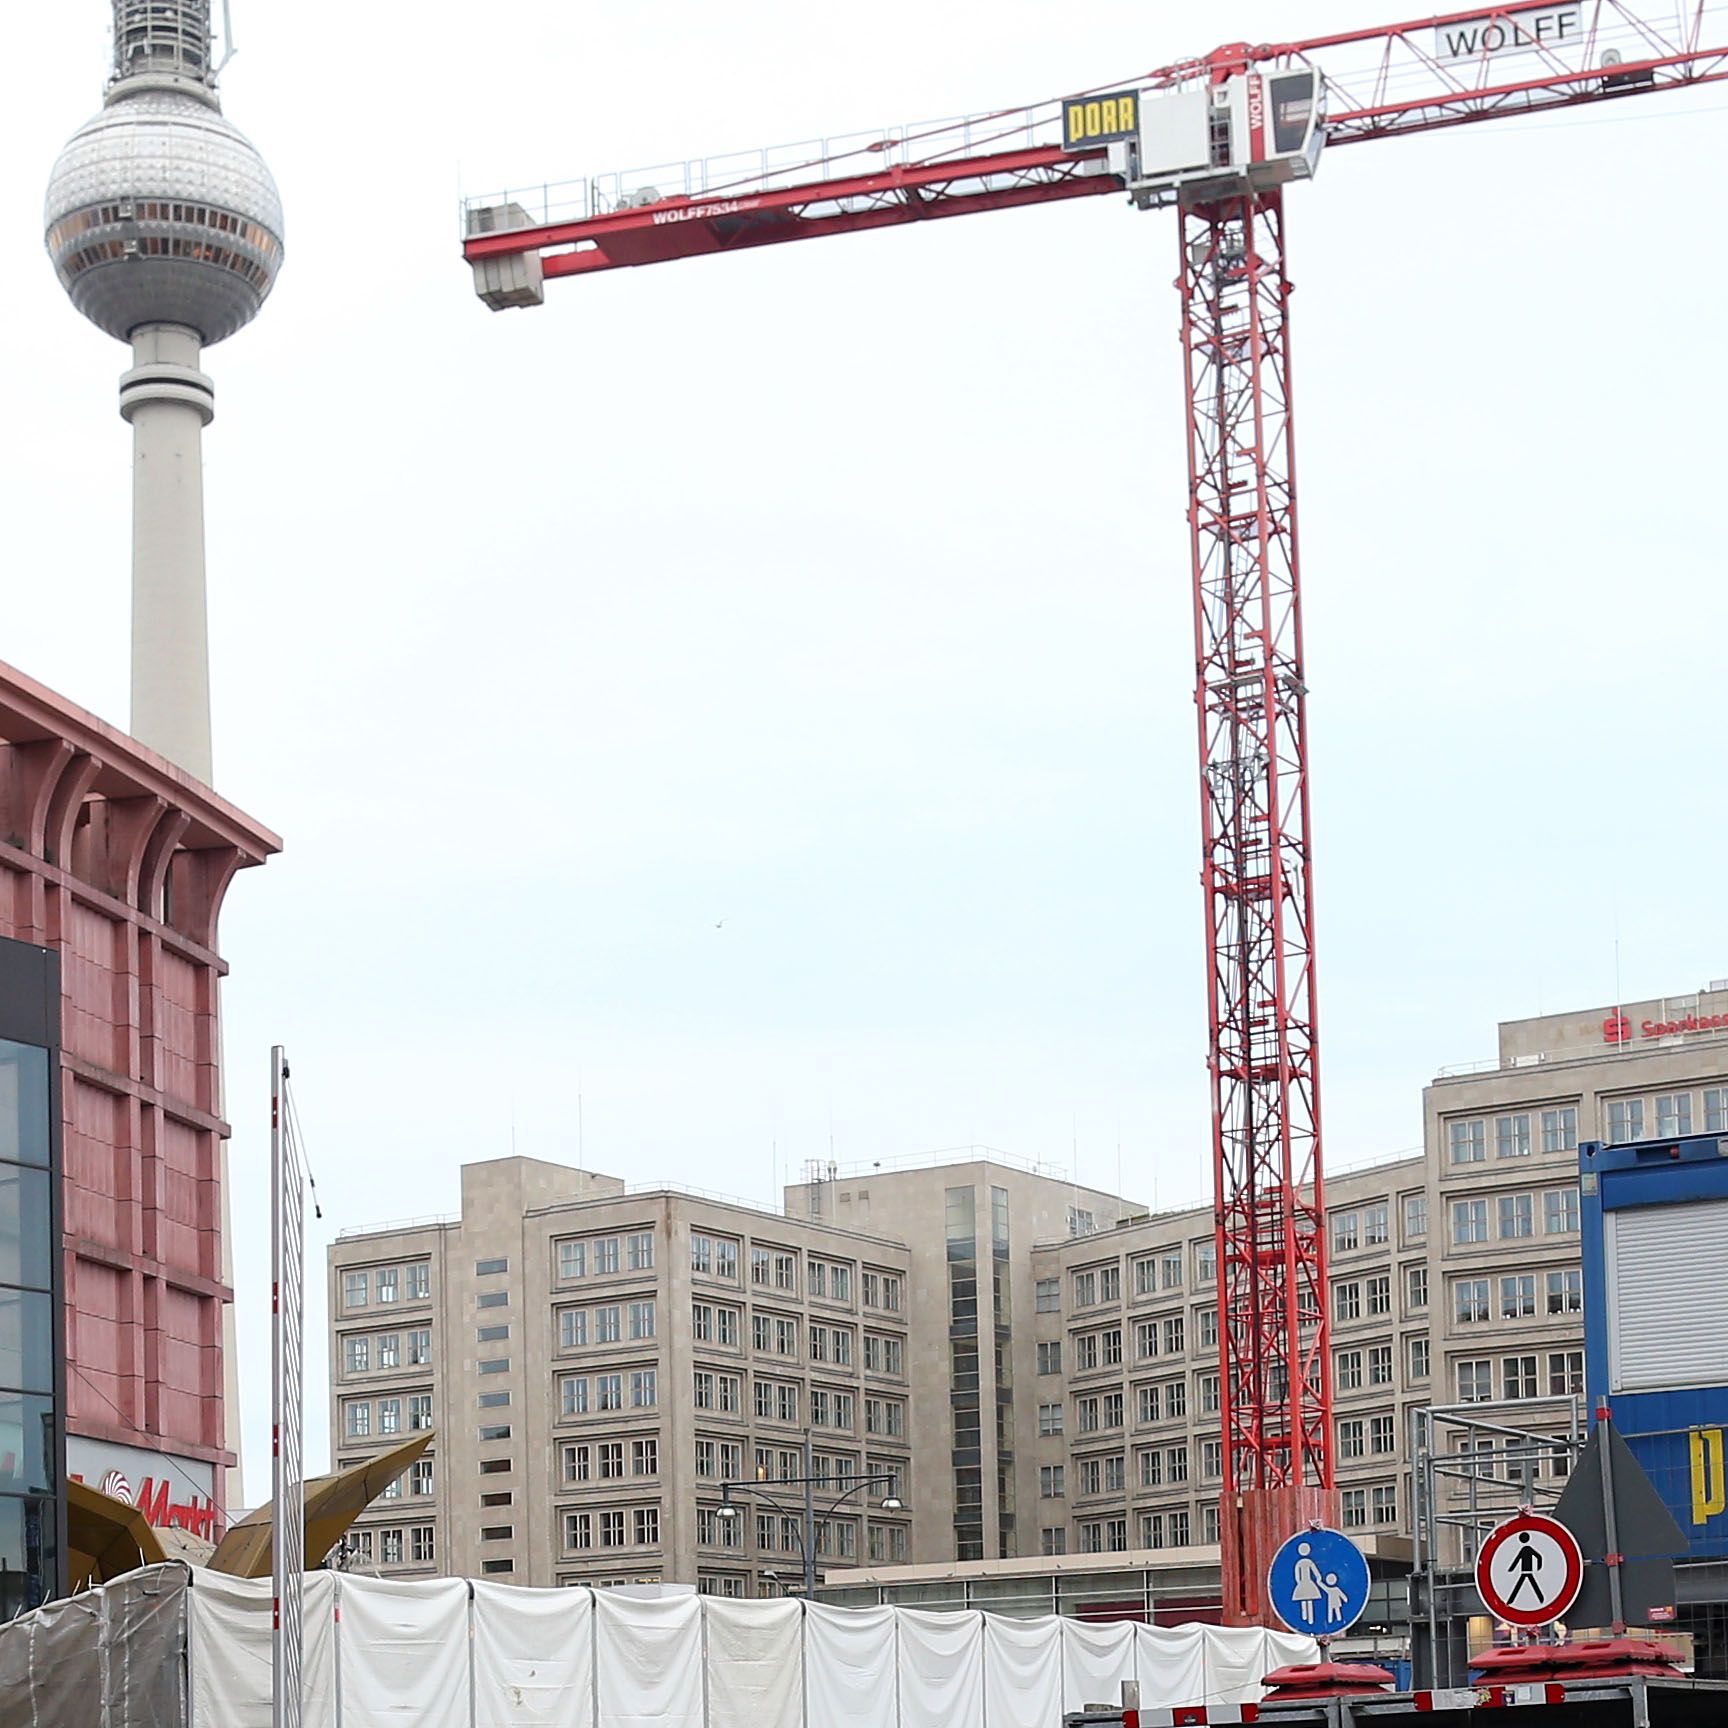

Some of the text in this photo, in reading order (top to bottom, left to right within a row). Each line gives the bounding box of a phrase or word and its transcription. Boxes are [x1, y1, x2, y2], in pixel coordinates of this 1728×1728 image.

[1446, 11, 1577, 58] WOLFF
[1068, 96, 1135, 143] PORR
[1248, 75, 1265, 131] WOLFF
